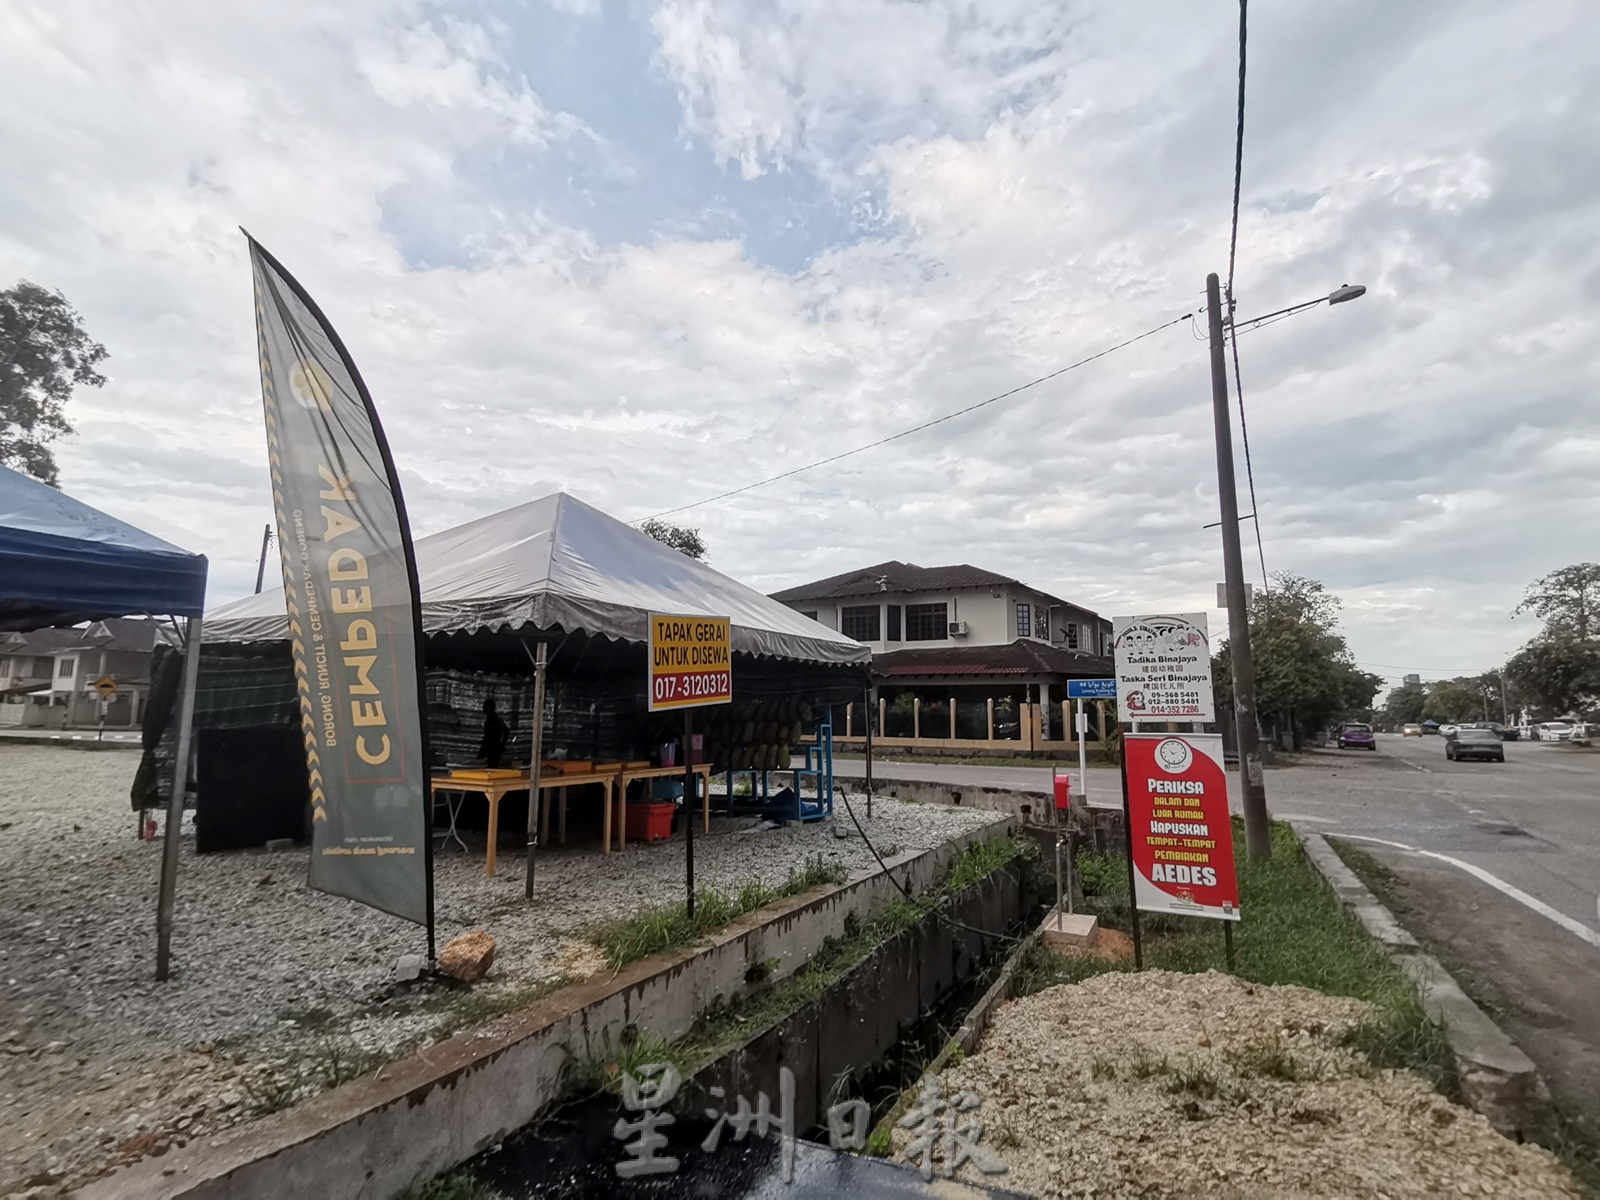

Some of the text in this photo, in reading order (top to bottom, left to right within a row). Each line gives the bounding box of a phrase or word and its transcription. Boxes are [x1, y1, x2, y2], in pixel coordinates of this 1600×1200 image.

[658, 622, 726, 642] TAPAK GERAI
[654, 645, 729, 666] UNTUK DISEWA
[1158, 655, 1197, 664] Binajaya
[1147, 674, 1166, 682] Seri
[1167, 673, 1208, 682] Binajaya
[655, 673, 728, 700] 017-3120312
[1181, 705, 1200, 713] 7286
[1147, 778, 1205, 795] PERIKSA
[1154, 796, 1200, 807] DALAM DAN
[1152, 808, 1204, 820] LUAR RUMAH
[1150, 820, 1209, 837] HAPUSKAN
[1145, 836, 1216, 849] TEMPAT-TEMPAT
[1154, 849, 1209, 863] PEMBIAKAN
[1151, 863, 1217, 887] AEDES
